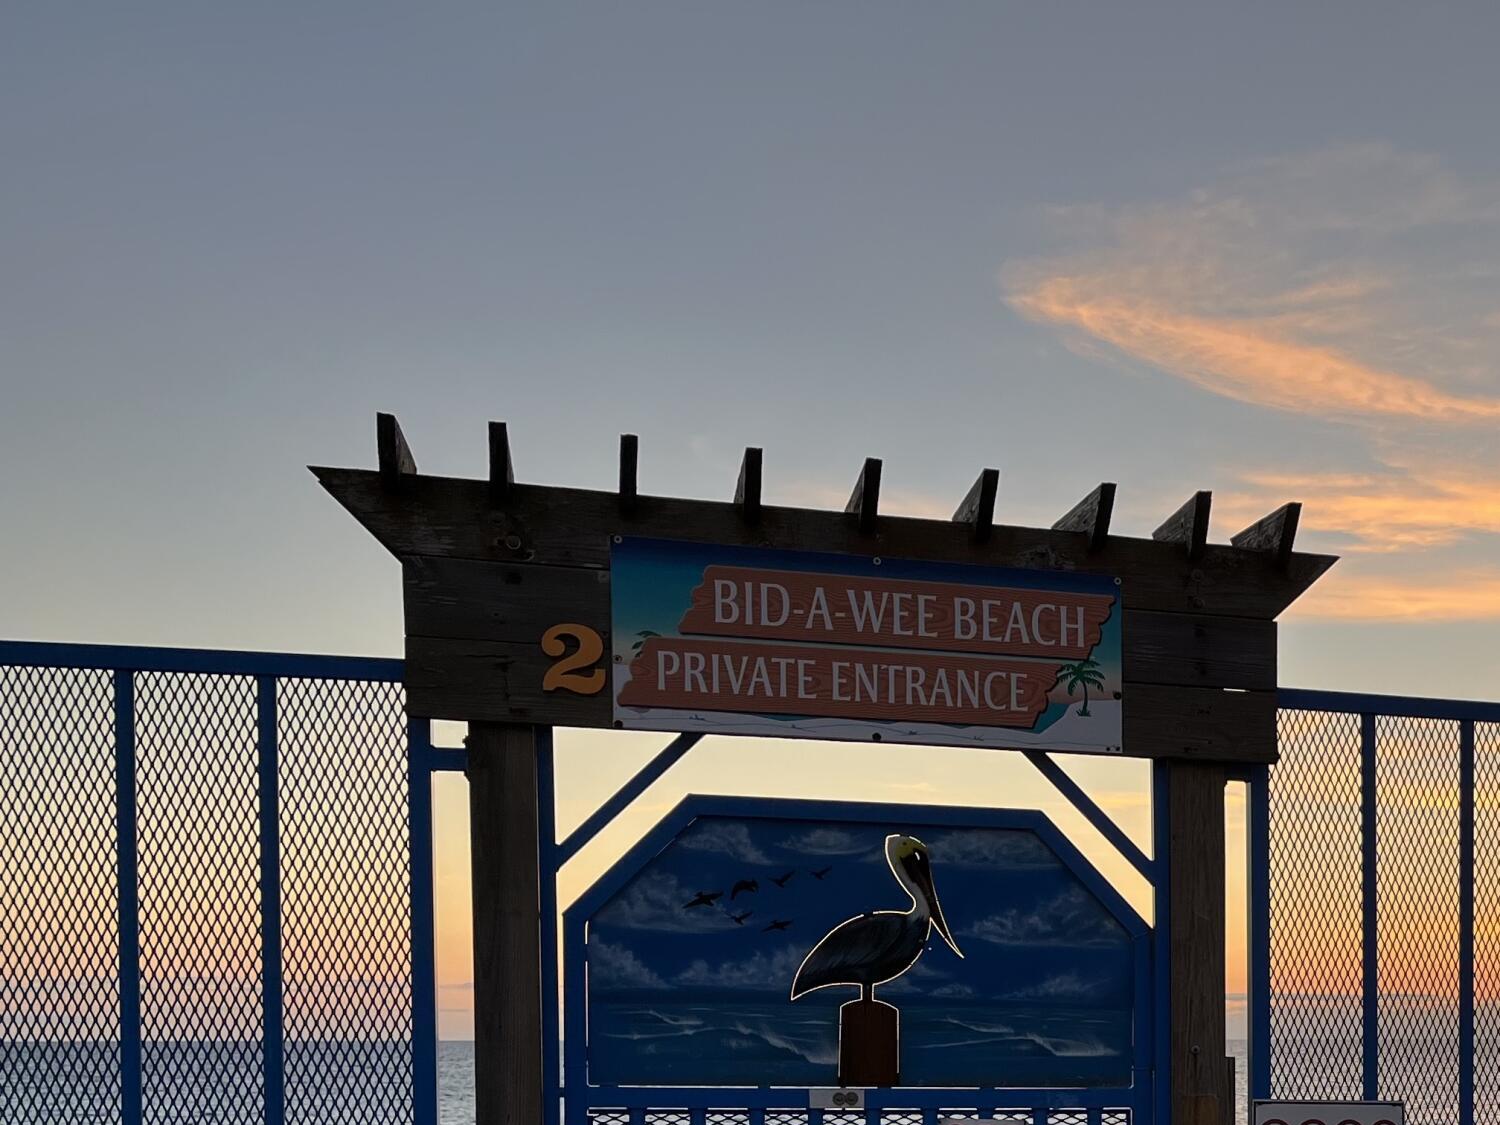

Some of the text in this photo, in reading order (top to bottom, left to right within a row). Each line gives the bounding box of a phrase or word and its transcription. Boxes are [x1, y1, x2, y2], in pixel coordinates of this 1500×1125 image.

[713, 579, 1086, 648] BID-A-WEE BEACH
[541, 623, 606, 695] 2
[656, 650, 1028, 712] PRIVATE ENTRANCE
